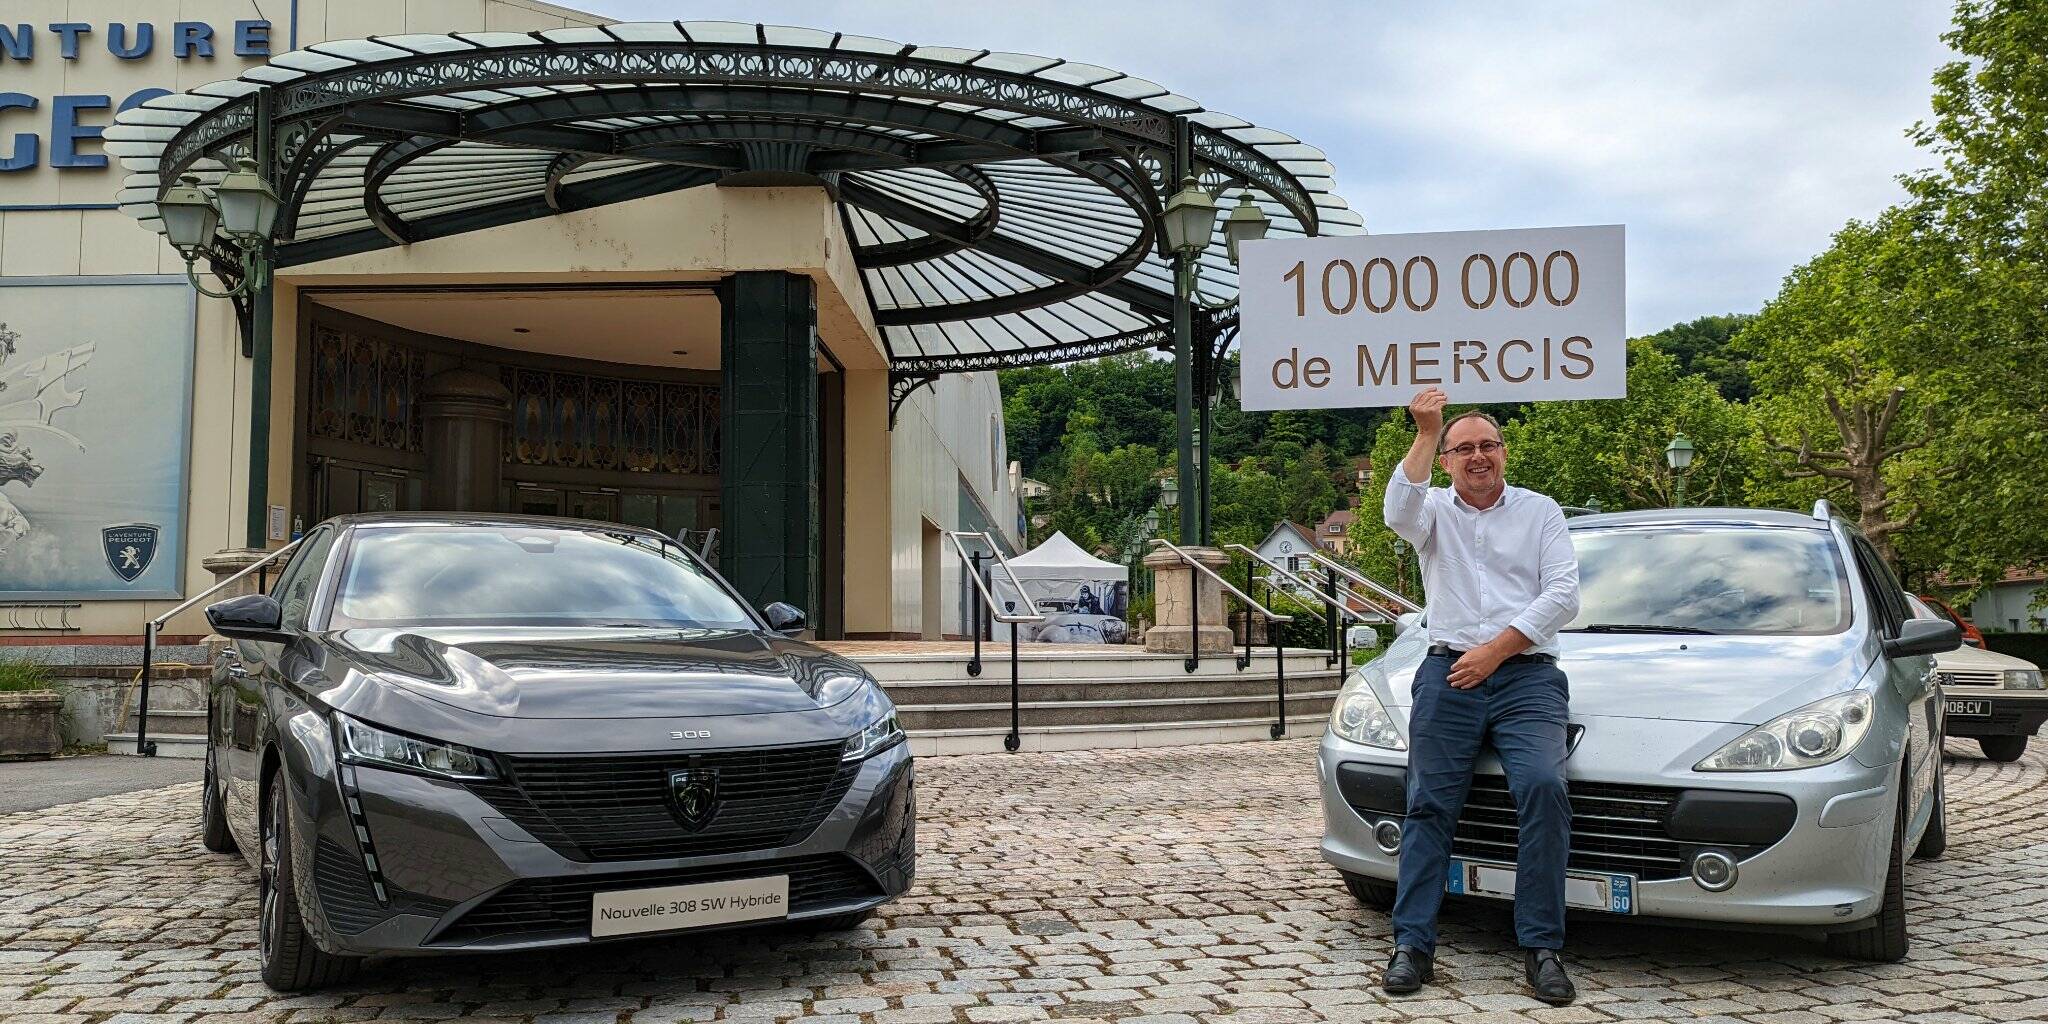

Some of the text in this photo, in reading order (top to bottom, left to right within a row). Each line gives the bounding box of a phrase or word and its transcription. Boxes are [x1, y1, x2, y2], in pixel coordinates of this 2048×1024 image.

[1461, 250, 1580, 310] 000
[1271, 335, 1595, 390] de MERCIS
[670, 730, 711, 739] 308
[1453, 880, 1459, 888] F
[600, 893, 782, 920] Nouvelle 308 SW Hybride
[1613, 895, 1630, 910] 60
